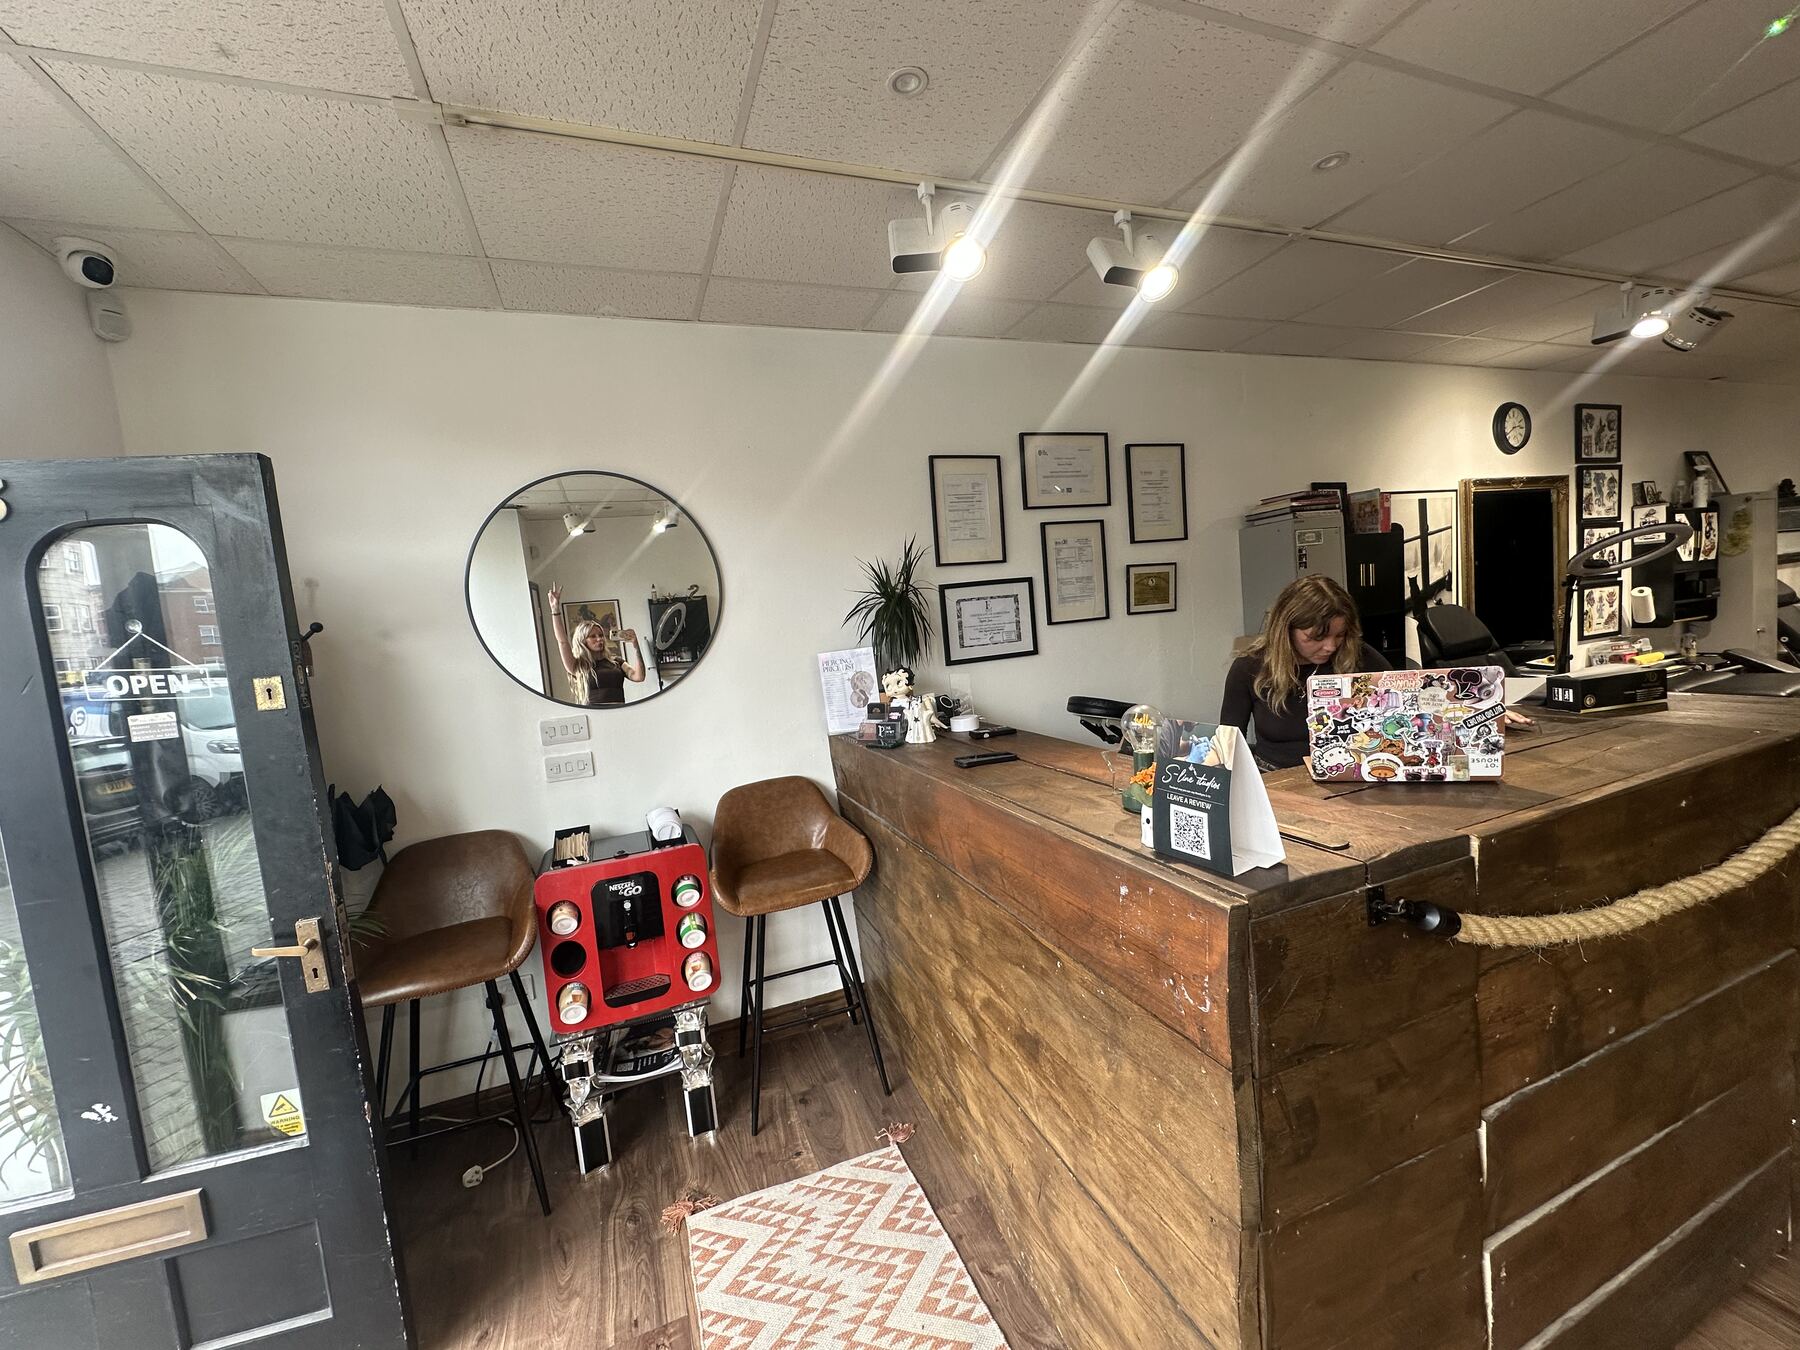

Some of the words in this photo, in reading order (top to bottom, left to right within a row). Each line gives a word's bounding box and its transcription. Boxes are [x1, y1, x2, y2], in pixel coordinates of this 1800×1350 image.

[822, 658, 852, 667] PIERCING
[822, 665, 840, 673] PRICE
[840, 663, 855, 671] LIST
[106, 674, 191, 696] OPEN
[1493, 705, 1504, 714] BUT
[1475, 713, 1487, 723] YOU
[1166, 793, 1184, 803] LEAVE
[1189, 798, 1212, 810] REVIEW
[624, 885, 642, 897] GO
[271, 1115, 300, 1125] WARNING
